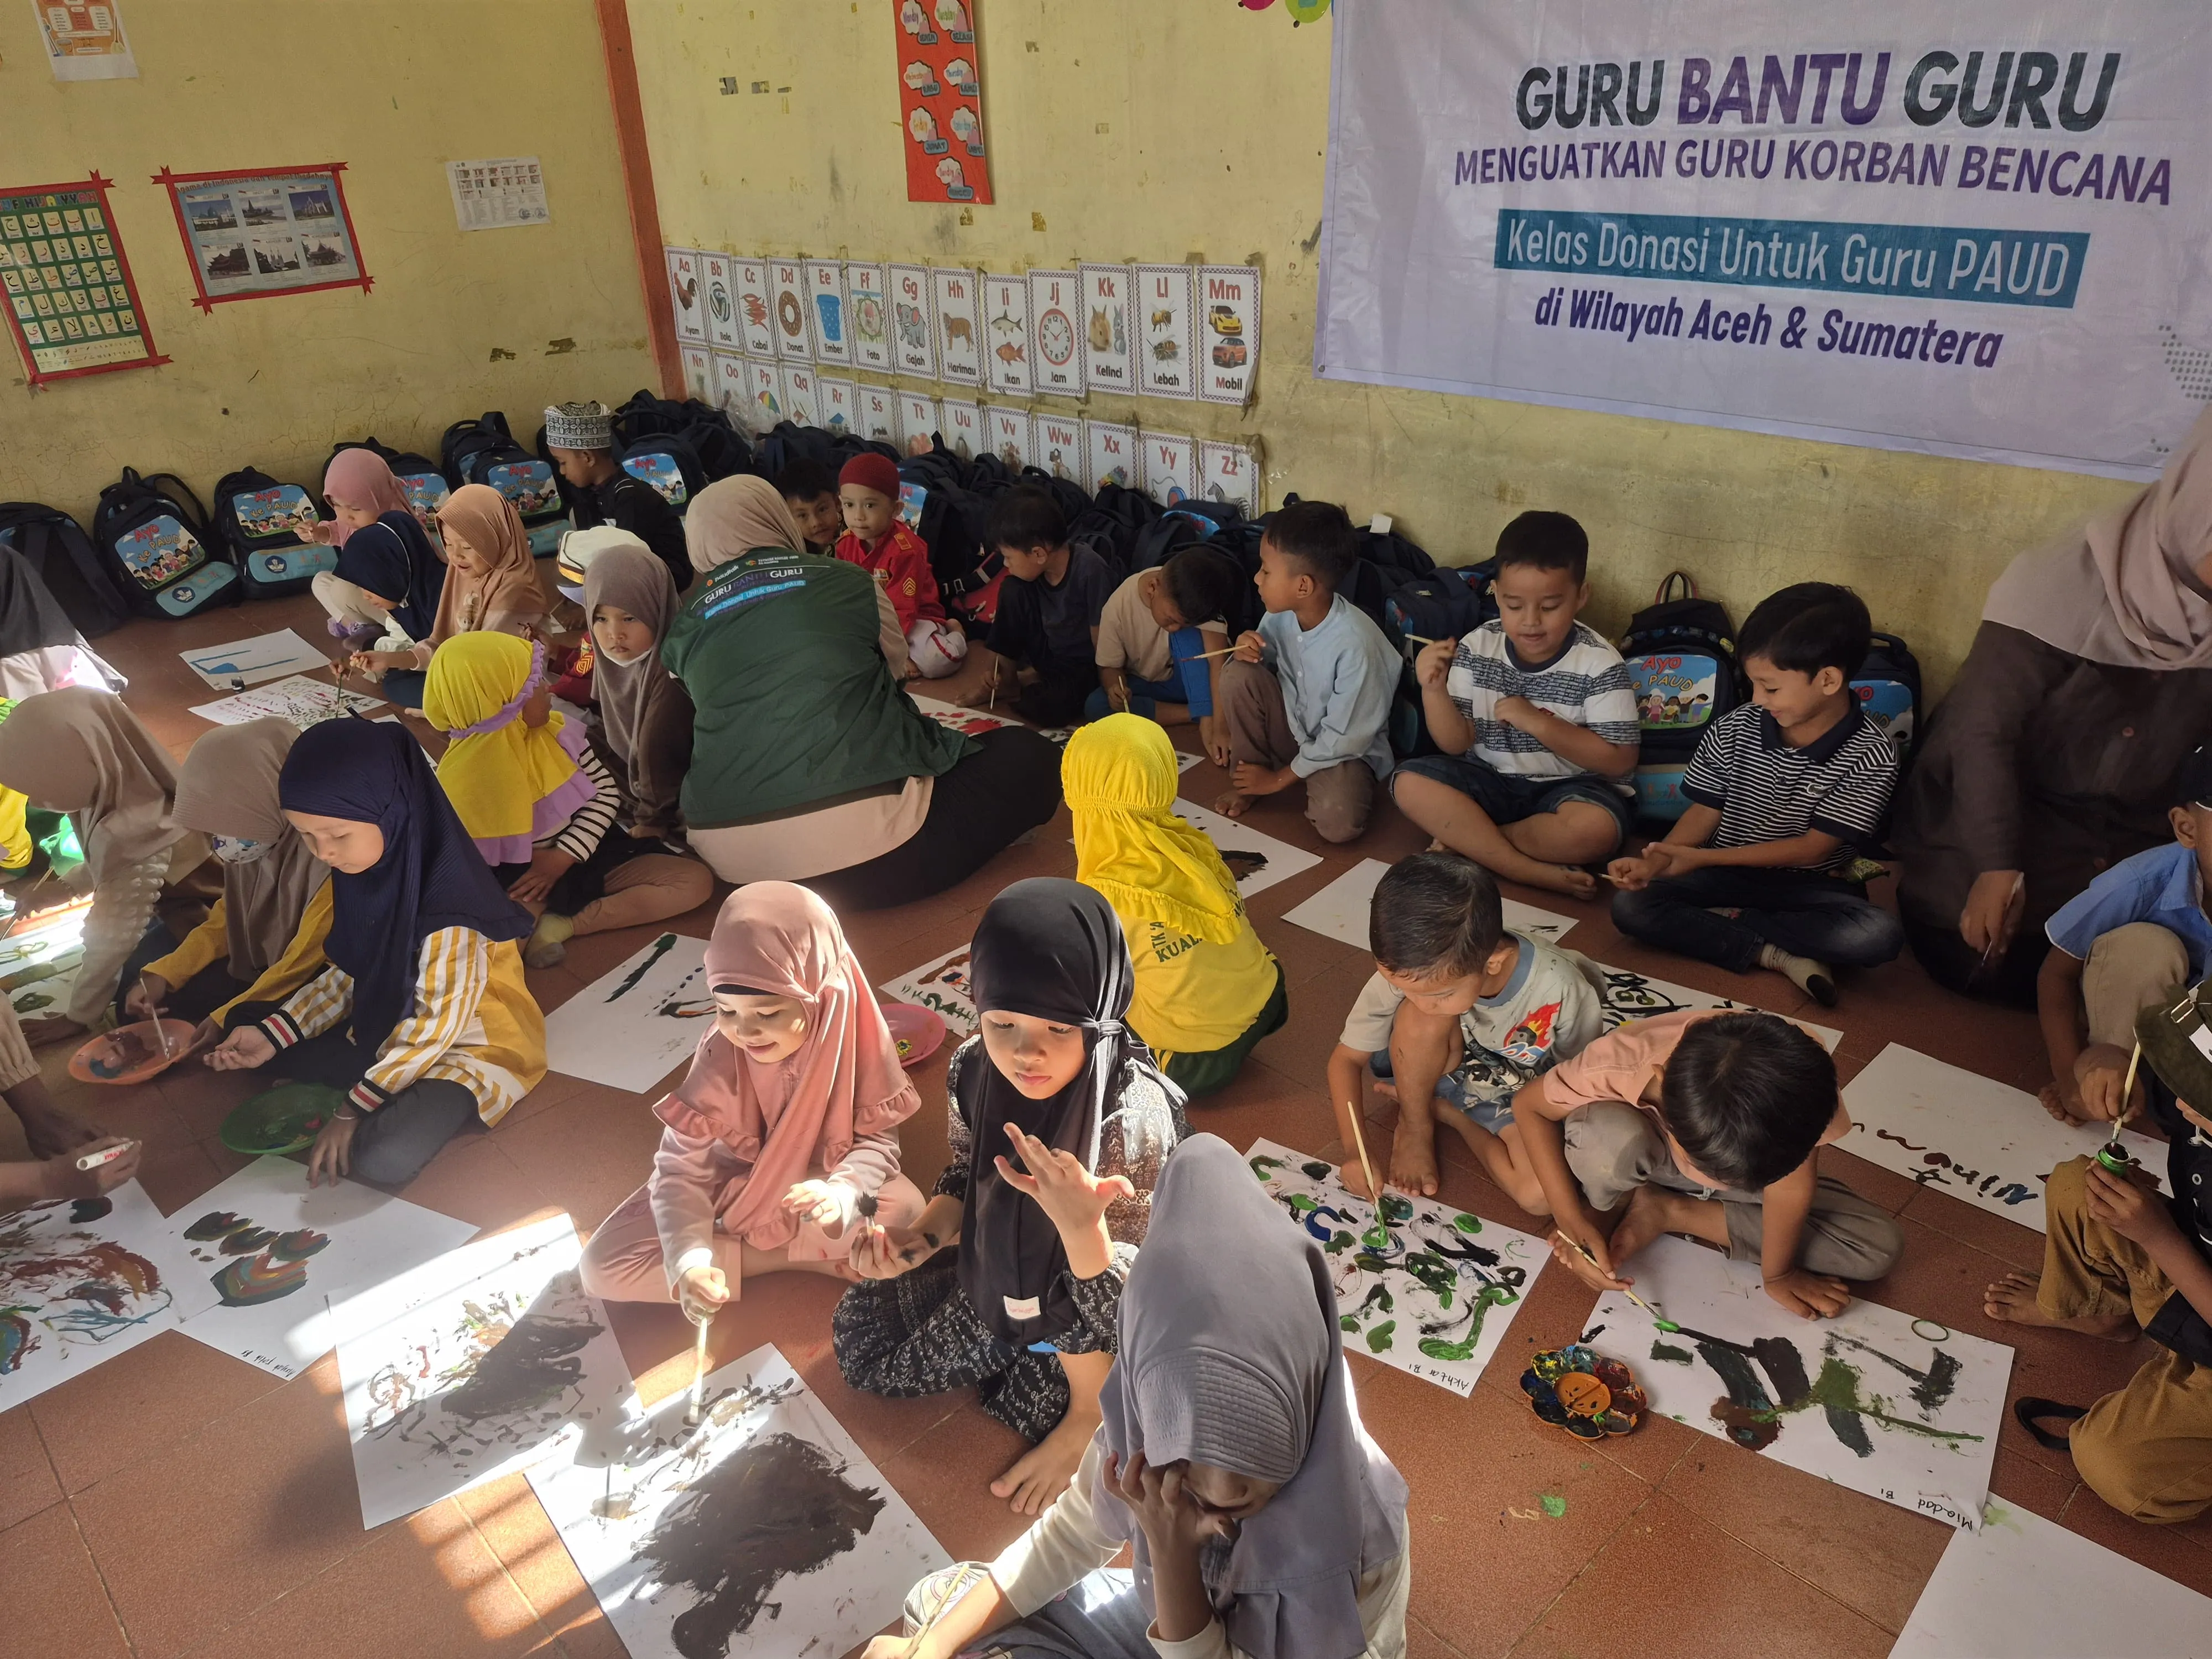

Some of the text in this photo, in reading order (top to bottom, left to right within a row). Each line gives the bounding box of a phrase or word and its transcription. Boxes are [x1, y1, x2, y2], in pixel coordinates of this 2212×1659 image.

[1516, 51, 2121, 132] GURU BANTU GURU
[1455, 139, 2171, 205] MENGUATKAN GURU KORBAN BENCANA
[1507, 218, 2069, 296] Kelas Donasi Untuk Guru PAUD
[679, 259, 690, 273] Aa
[710, 260, 722, 277] Bb
[745, 267, 756, 284] Cc
[781, 268, 794, 284] Dd
[818, 268, 831, 285] Ee
[860, 272, 870, 289] Ff
[902, 276, 918, 300] Gg
[947, 280, 964, 299] Hh
[1001, 287, 1009, 306] Ii
[1049, 281, 1060, 305] Jj
[1098, 278, 1115, 298] Kk
[1156, 278, 1168, 298] Ll
[1209, 279, 1241, 301] Mm
[685, 326, 700, 336] Ayam
[1535, 287, 2004, 368] di Wilayah Aceh & Sumatera
[720, 332, 732, 342] Bola
[752, 340, 769, 351] Cabai
[787, 342, 804, 353] Donat
[825, 343, 843, 355] Ember
[867, 349, 880, 361] Foto
[692, 354, 704, 368] Nn
[906, 353, 925, 367] Gajah
[726, 364, 739, 379] Oo
[760, 369, 771, 385] Pp
[947, 362, 977, 376] Harimau
[1095, 364, 1123, 379] Kelinci
[794, 374, 808, 392] Qq
[1050, 372, 1067, 384] Jam
[1154, 372, 1180, 387] Lebah
[1216, 375, 1243, 390] Mobil
[832, 388, 843, 404] Rr
[872, 397, 883, 413] Ss
[912, 403, 925, 420] Tt
[955, 410, 971, 428] Uu
[1000, 418, 1016, 436] Vv
[1047, 426, 1072, 446] Ww
[1103, 435, 1120, 455] Xx
[1159, 445, 1177, 470] Yy
[1221, 455, 1238, 476] Zz
[518, 479, 545, 489] PAUD
[409, 491, 440, 503] PAUD
[250, 501, 298, 518] Ke PAUD
[149, 535, 181, 550] PAUD
[138, 550, 151, 563] Ke
[714, 565, 739, 582] paudtalk
[705, 584, 732, 604] GURU
[770, 568, 803, 578] GURU
[746, 588, 765, 599] Untuk
[1632, 675, 1694, 691] e PAUD
[1151, 932, 1166, 949] TK
[1428, 1369, 1469, 1390] Akhtar
